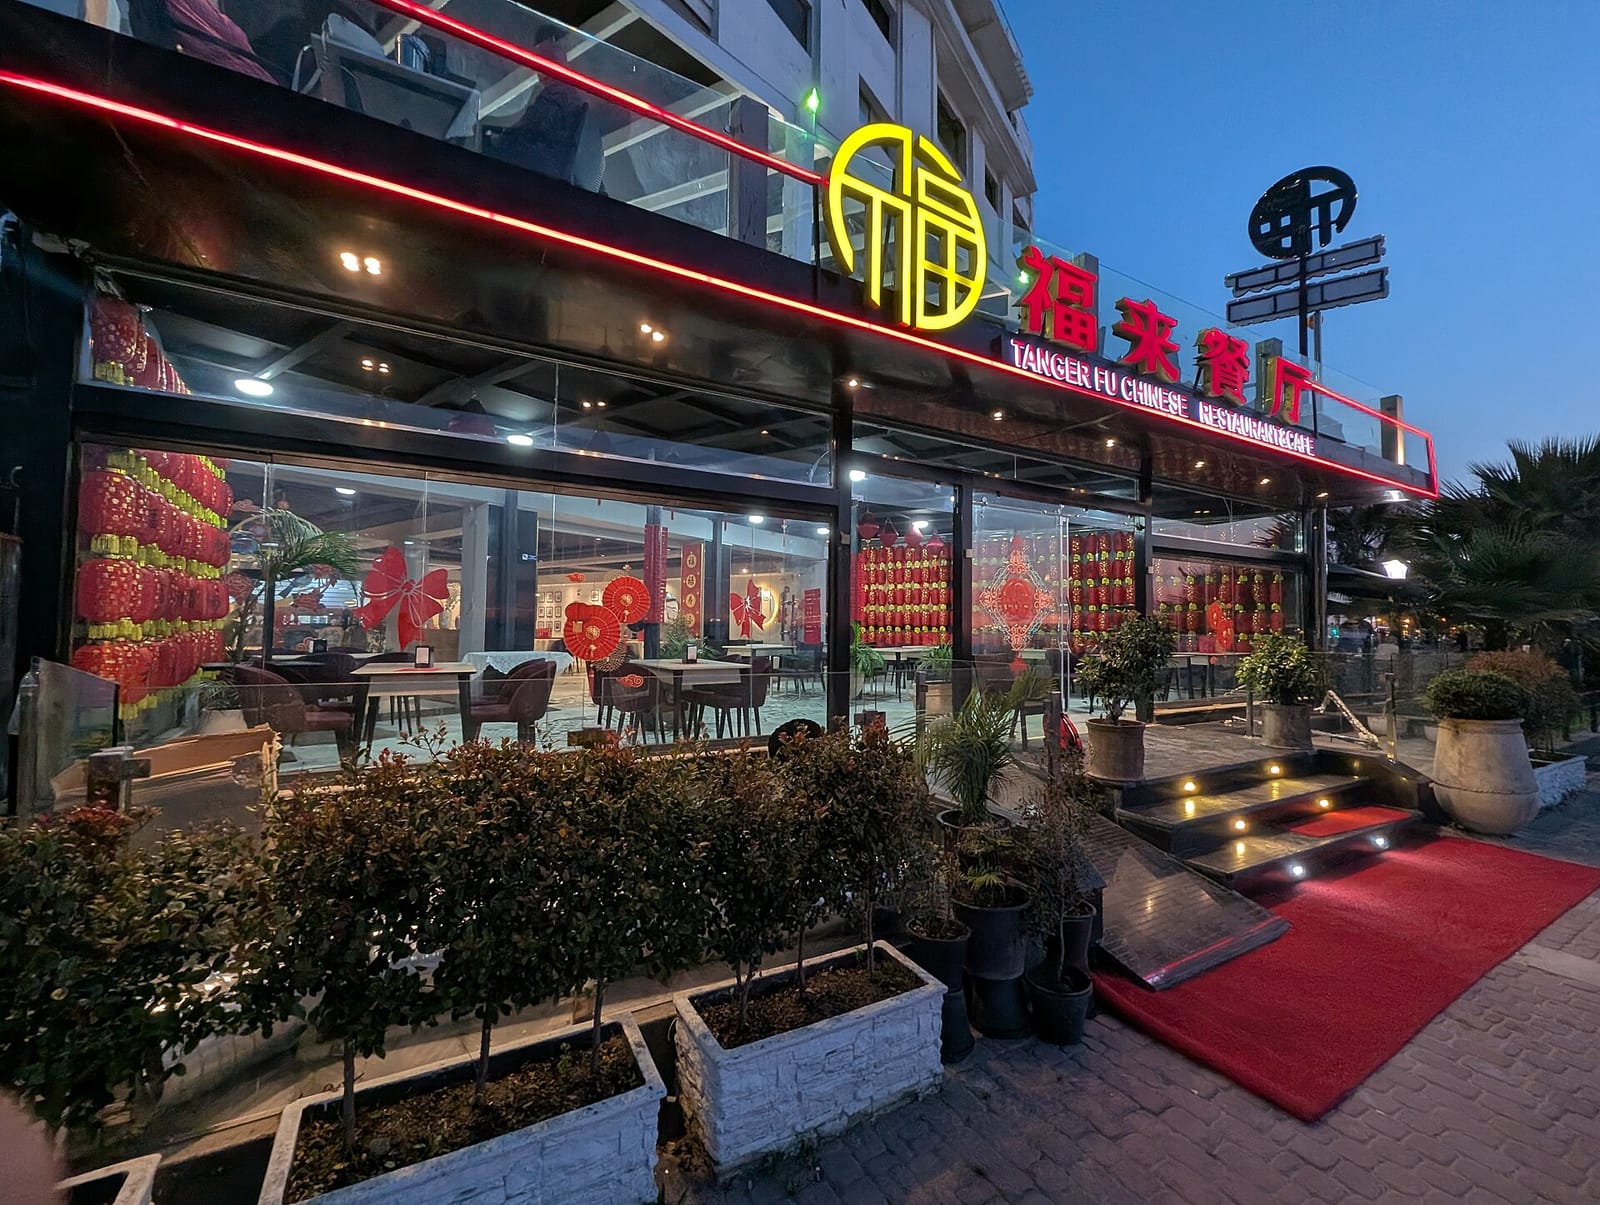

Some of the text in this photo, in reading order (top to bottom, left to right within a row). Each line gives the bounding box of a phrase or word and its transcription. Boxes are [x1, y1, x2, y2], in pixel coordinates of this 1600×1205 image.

[1010, 338, 1092, 389] TANGER
[1094, 366, 1119, 397] FU
[1120, 375, 1190, 418] CHINESE
[1020, 245, 1313, 425] 福来餐厅
